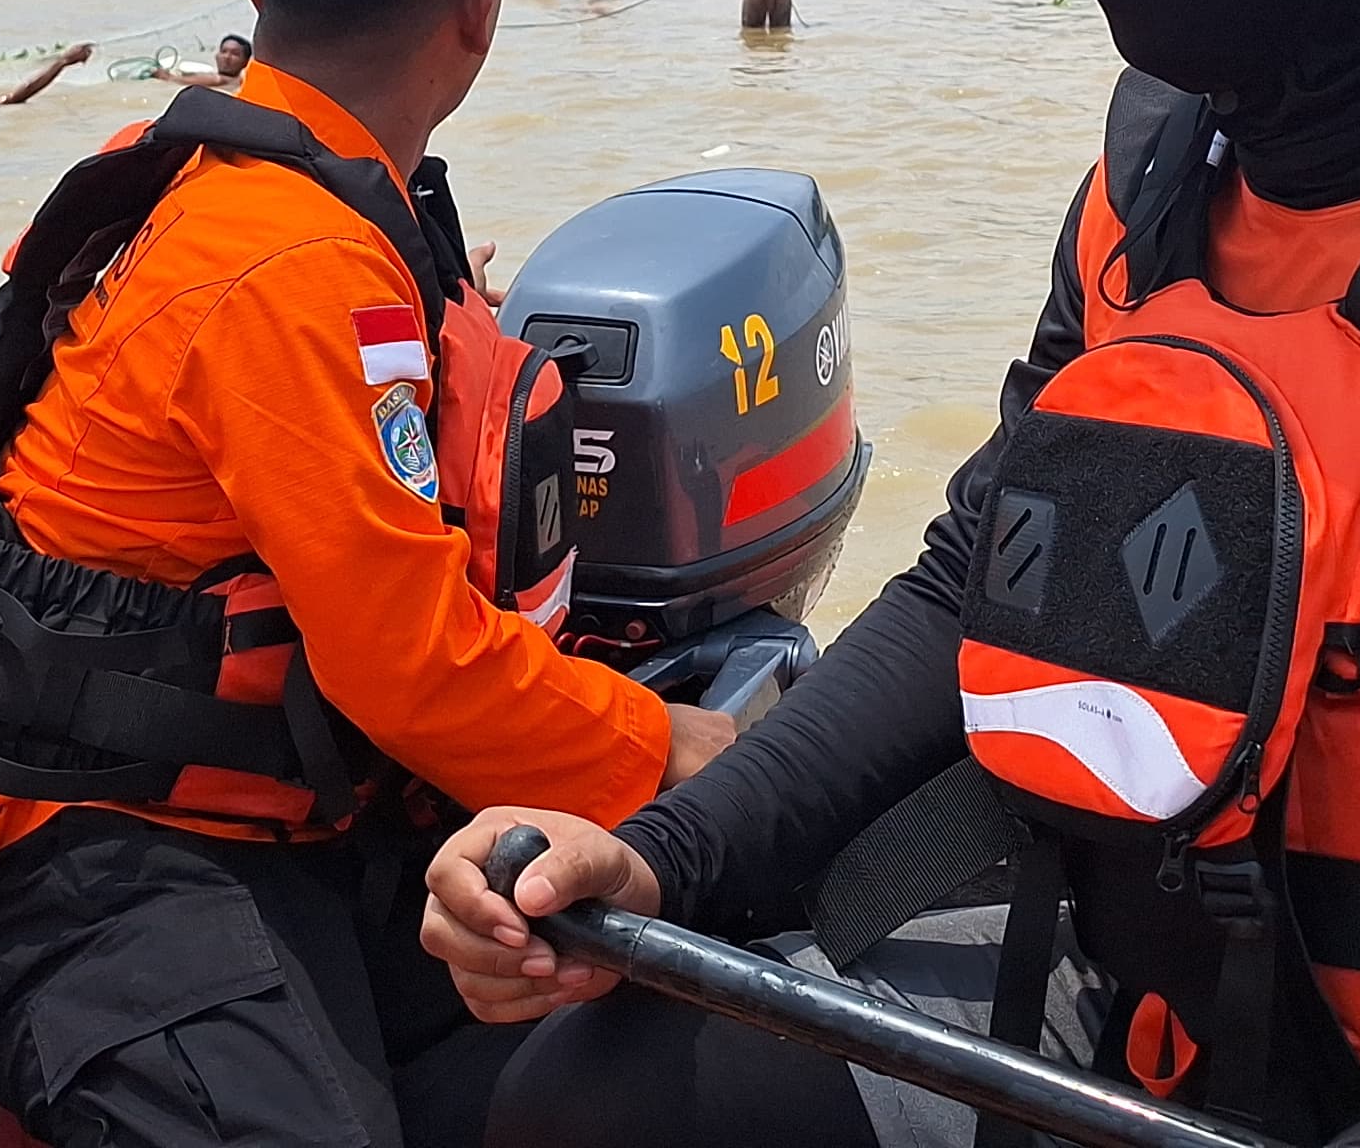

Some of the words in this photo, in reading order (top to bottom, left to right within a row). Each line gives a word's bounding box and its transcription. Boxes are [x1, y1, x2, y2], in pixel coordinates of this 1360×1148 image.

[720, 313, 780, 415] 12
[572, 428, 616, 473] 5
[577, 498, 600, 518] AP
